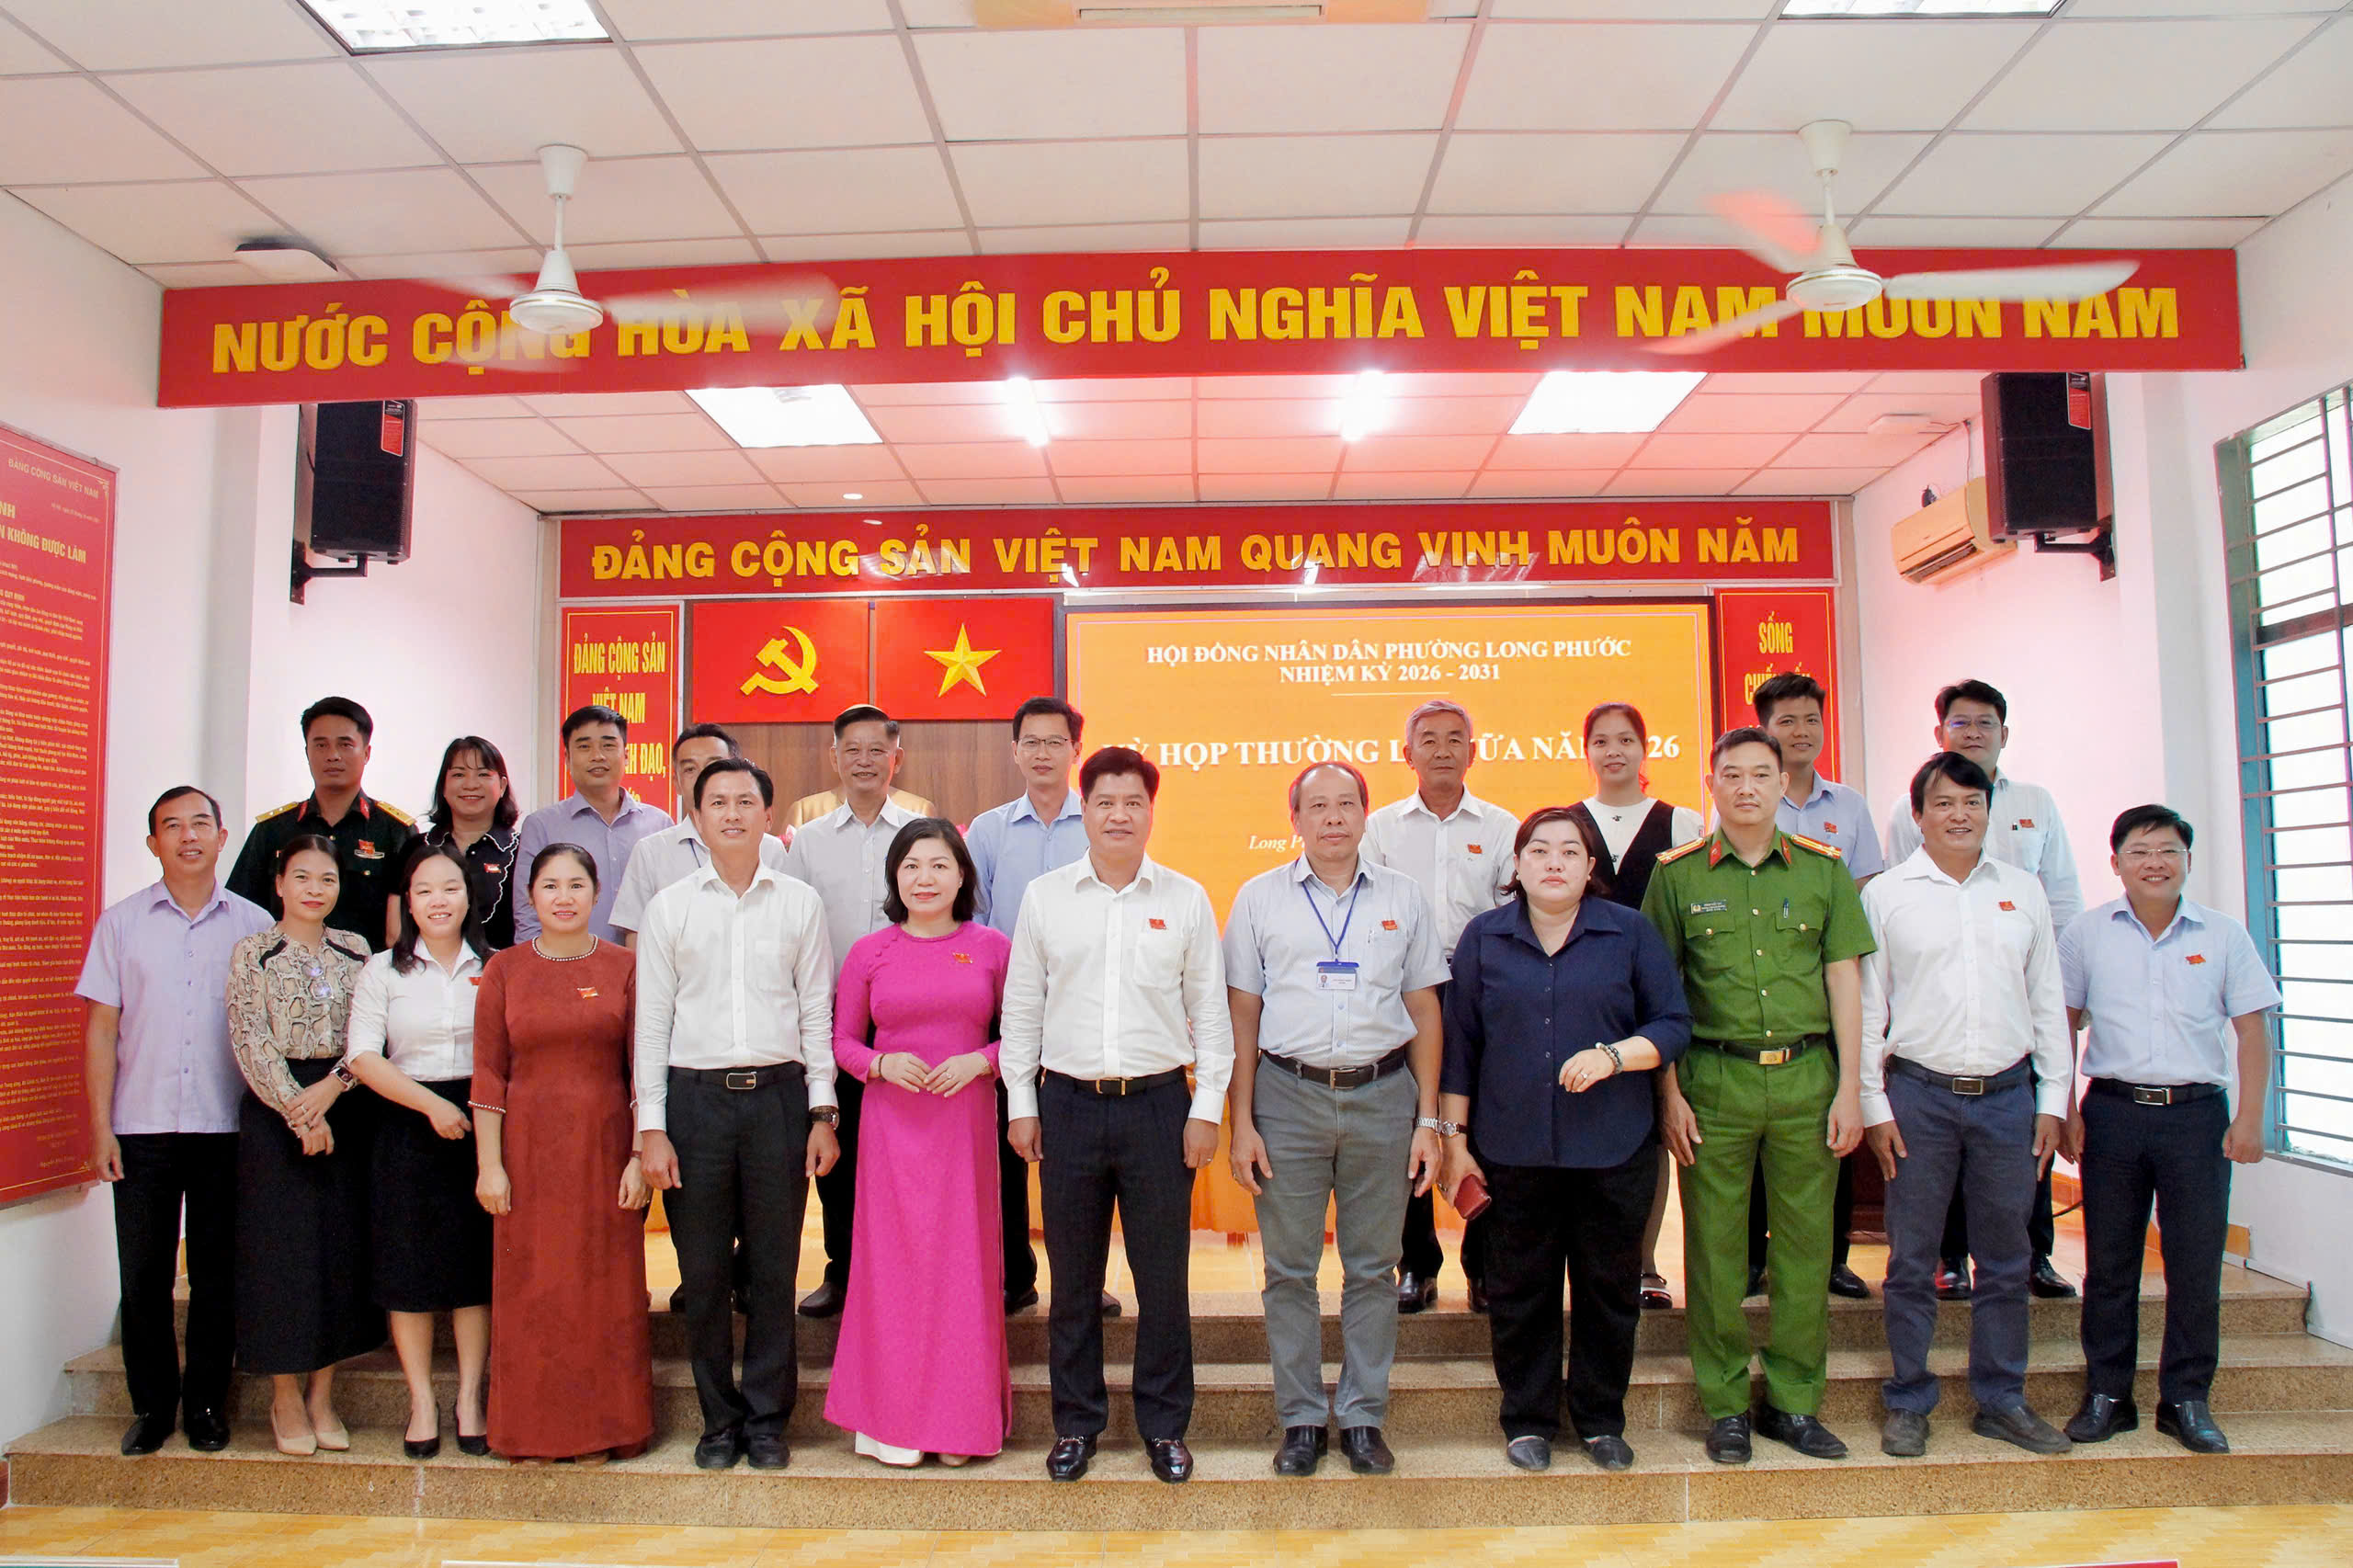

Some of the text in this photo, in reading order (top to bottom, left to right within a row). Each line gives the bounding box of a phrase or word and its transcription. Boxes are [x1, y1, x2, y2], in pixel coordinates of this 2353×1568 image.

[212, 302, 388, 374] NƯỚC
[413, 299, 590, 375] CỘNG
[618, 289, 750, 356] HÒA
[779, 286, 877, 350] XÃ
[905, 280, 1015, 358] HỘI
[1043, 267, 1181, 344] CHỦ
[1210, 273, 1425, 340] NGHĨA
[1443, 269, 1588, 349] VIỆT
[1615, 286, 1779, 338] NAM
[7, 526, 40, 550] KHÔNG
[592, 517, 1798, 587] ĐẢNG CỘNG SẢN VIỆT NAM QUANG VINH MUÔN NĂM
[1758, 610, 1793, 654] SỐNG
[574, 631, 665, 681] ĐẢNG CỘNG SẢN
[1147, 636, 1631, 666] HỘI ĐỒNG NHÂN DÂN PHƯỜNG LONG PHƯỚC
[1279, 665, 1354, 686] NHIỆM
[1360, 661, 1392, 681] KỲ
[1398, 665, 1441, 681] 2026
[1459, 664, 1500, 680] 2031
[620, 693, 645, 723] NAM
[640, 743, 665, 781] ĐẠO,
[1160, 743, 1229, 771] HỌP
[1233, 735, 1380, 765] THƯỜNG
[1249, 835, 1287, 853] Long
